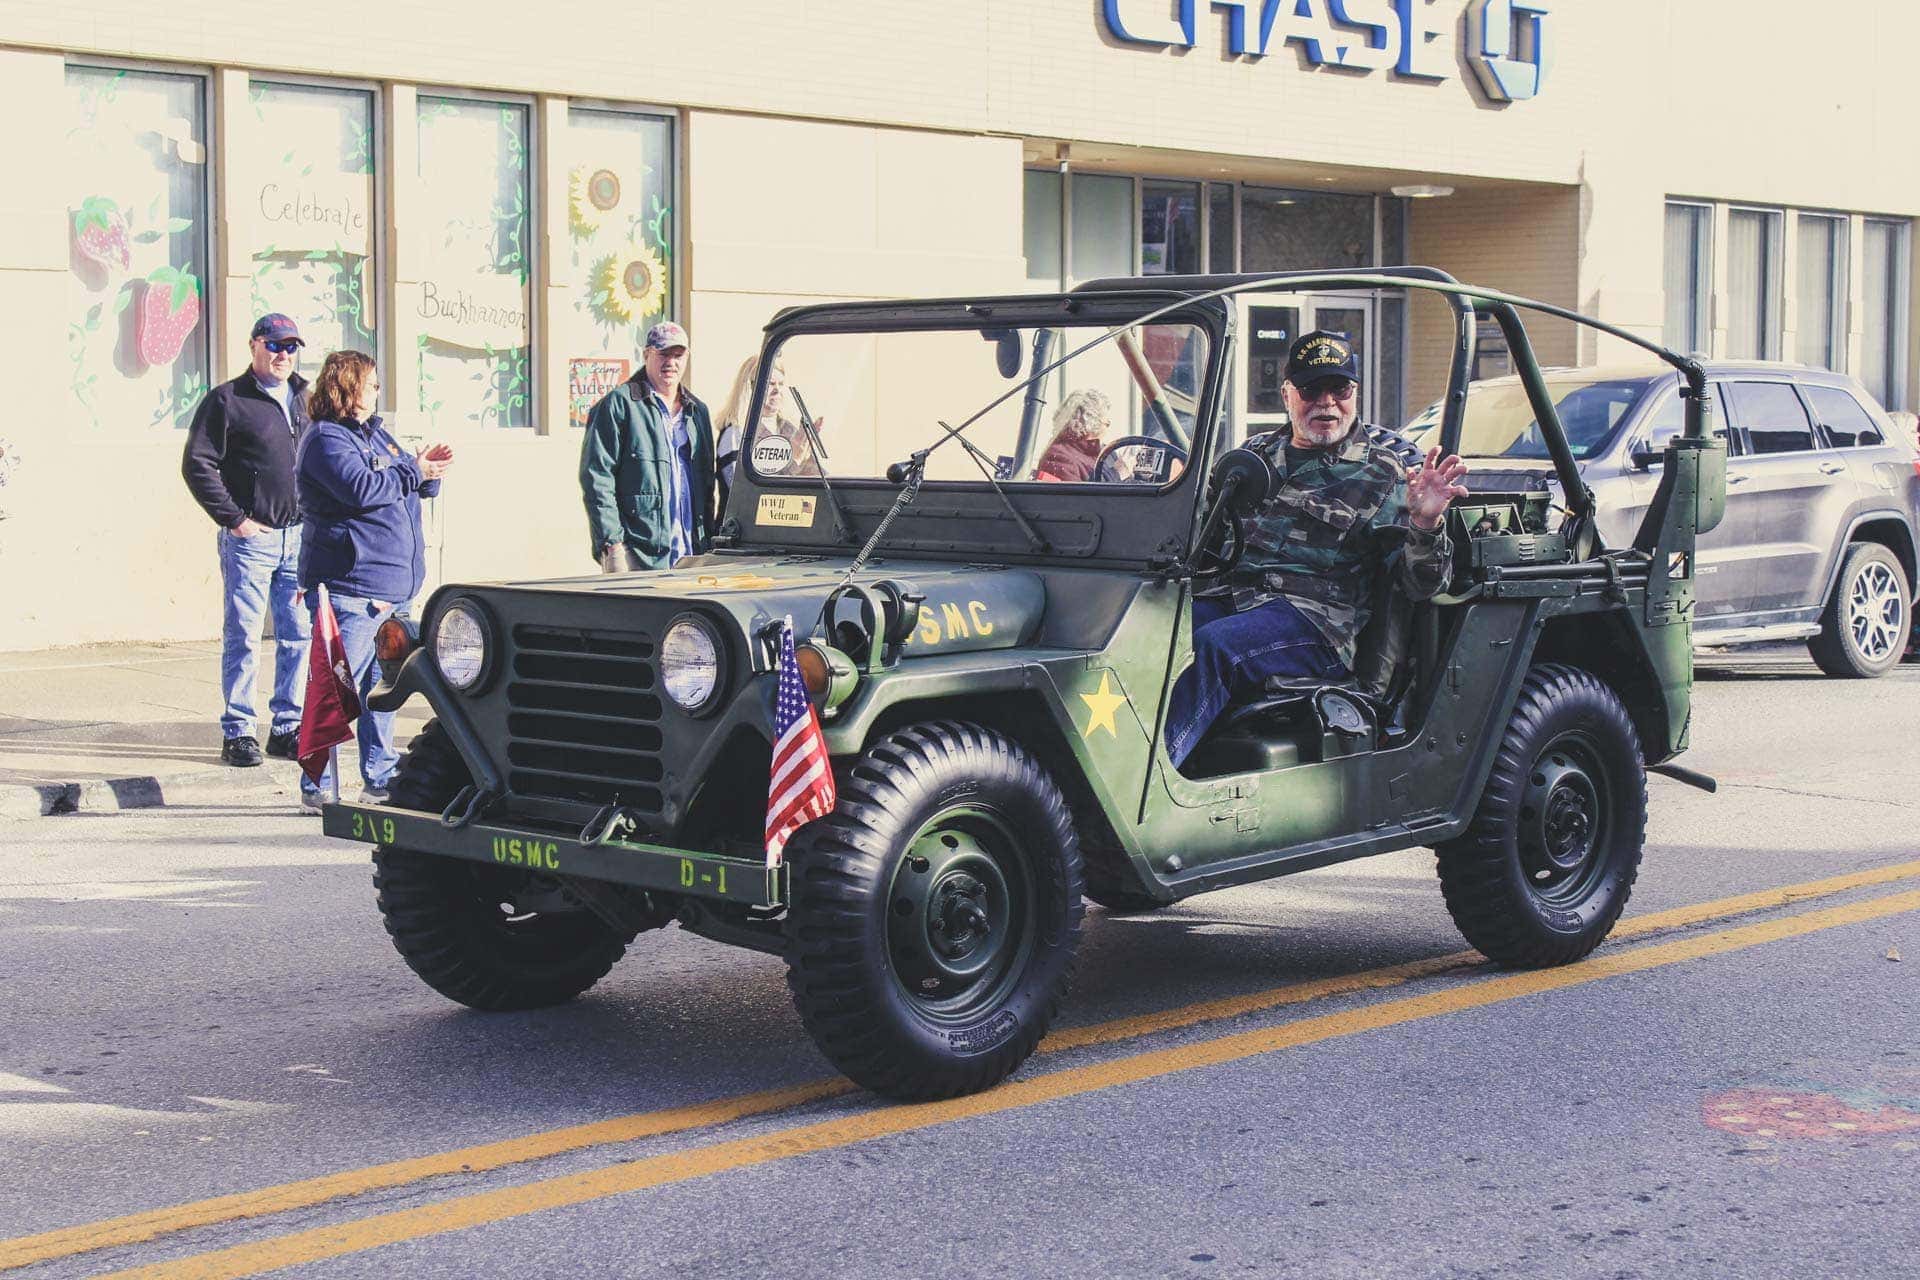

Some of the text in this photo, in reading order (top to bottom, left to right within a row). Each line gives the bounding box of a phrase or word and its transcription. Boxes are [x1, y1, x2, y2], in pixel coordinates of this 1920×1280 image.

[260, 183, 363, 235] Celebrate
[418, 280, 526, 329] Buckhannon
[1308, 357, 1341, 366] VETERAN
[753, 447, 791, 461] VETERAN
[761, 498, 785, 509] WWII
[770, 510, 799, 521] Veteran
[904, 600, 993, 645] SMC
[493, 837, 560, 870] USMC
[680, 858, 727, 894] D-1
